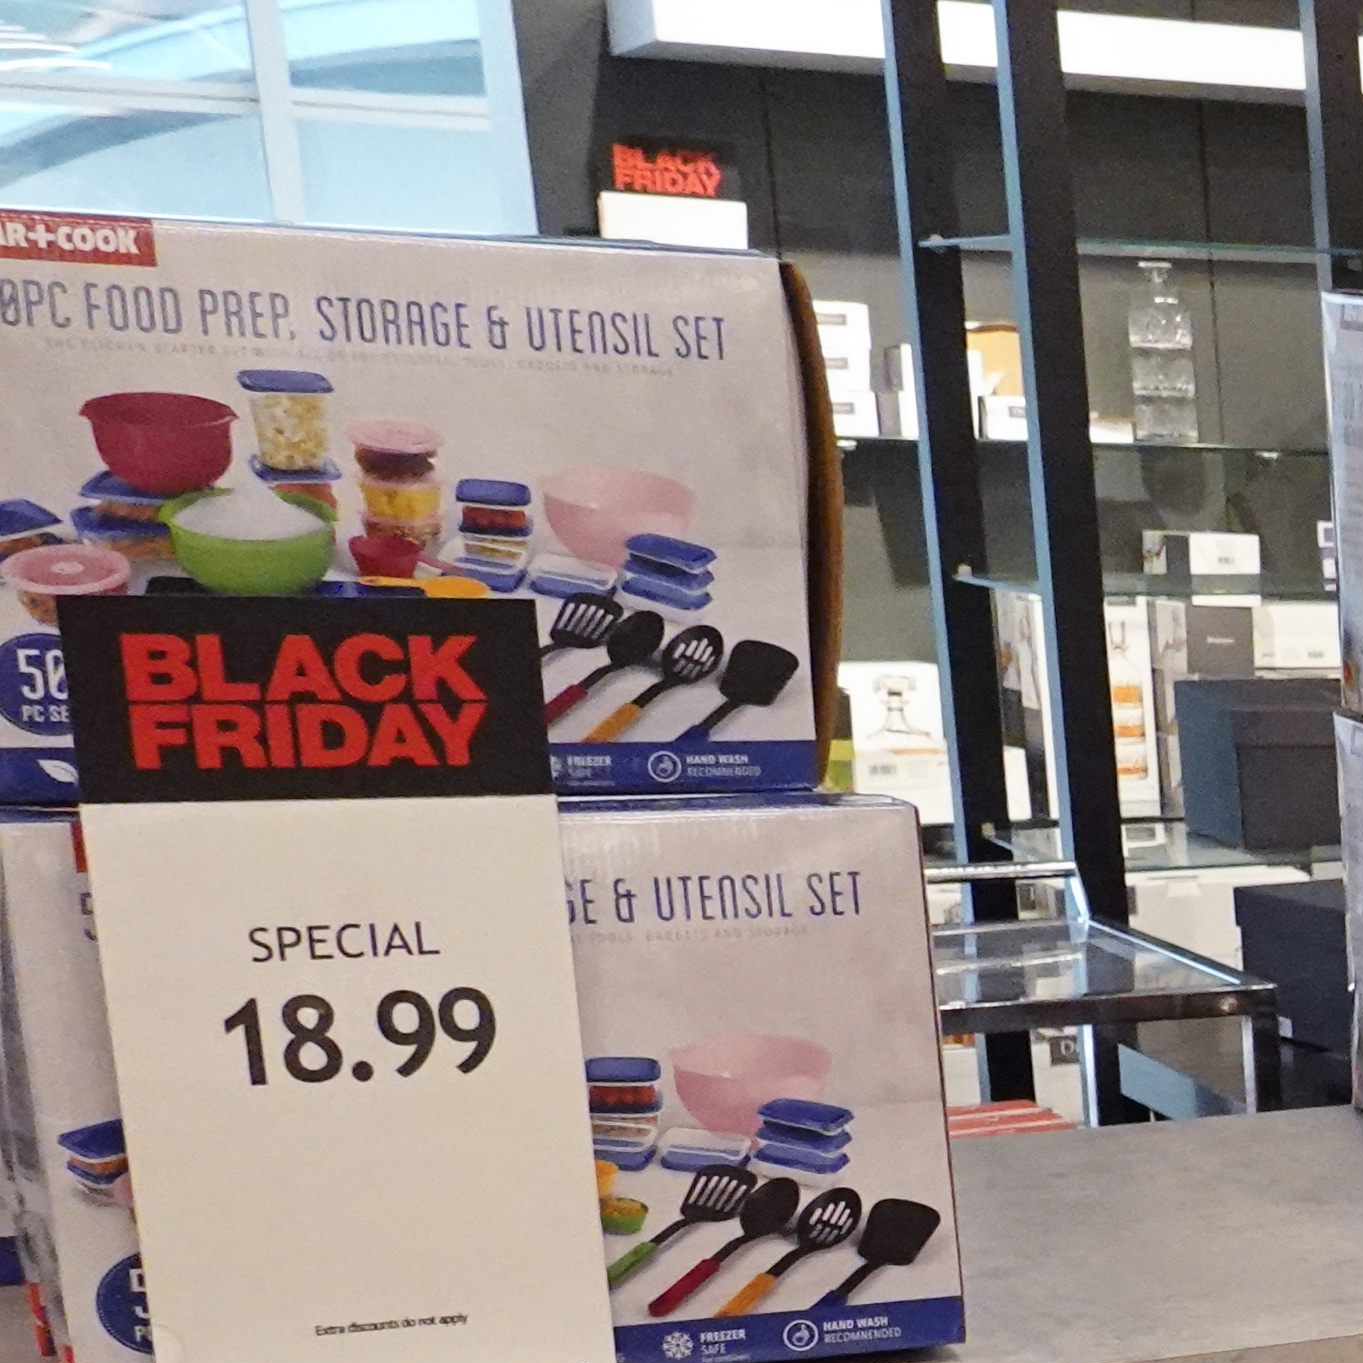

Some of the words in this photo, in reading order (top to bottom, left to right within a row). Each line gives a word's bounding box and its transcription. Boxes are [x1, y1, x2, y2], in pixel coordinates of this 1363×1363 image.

[614, 170, 721, 197] FRIDAY
[85, 283, 184, 335] FOOD
[316, 296, 471, 350] STORAGE
[487, 306, 509, 351] &
[526, 305, 661, 358] UTENSIL
[673, 315, 726, 361] SET
[119, 633, 488, 701] BLACK
[21, 704, 46, 722] PC
[129, 703, 488, 769] FRIDAY
[613, 877, 636, 923] &
[653, 873, 793, 921] UTENSIL
[807, 871, 861, 915] SET
[248, 920, 440, 963] SPECIAL
[223, 986, 497, 1087] 18.99
[316, 1323, 346, 1336] Extra
[348, 1319, 400, 1334] discounts
[402, 1317, 416, 1328] do
[418, 1314, 436, 1326] not
[439, 1312, 469, 1327] apply
[701, 1328, 747, 1343] FREEZER
[824, 1318, 854, 1331] HAND
[857, 1316, 888, 1329] WASH
[702, 1342, 727, 1355] SAFE
